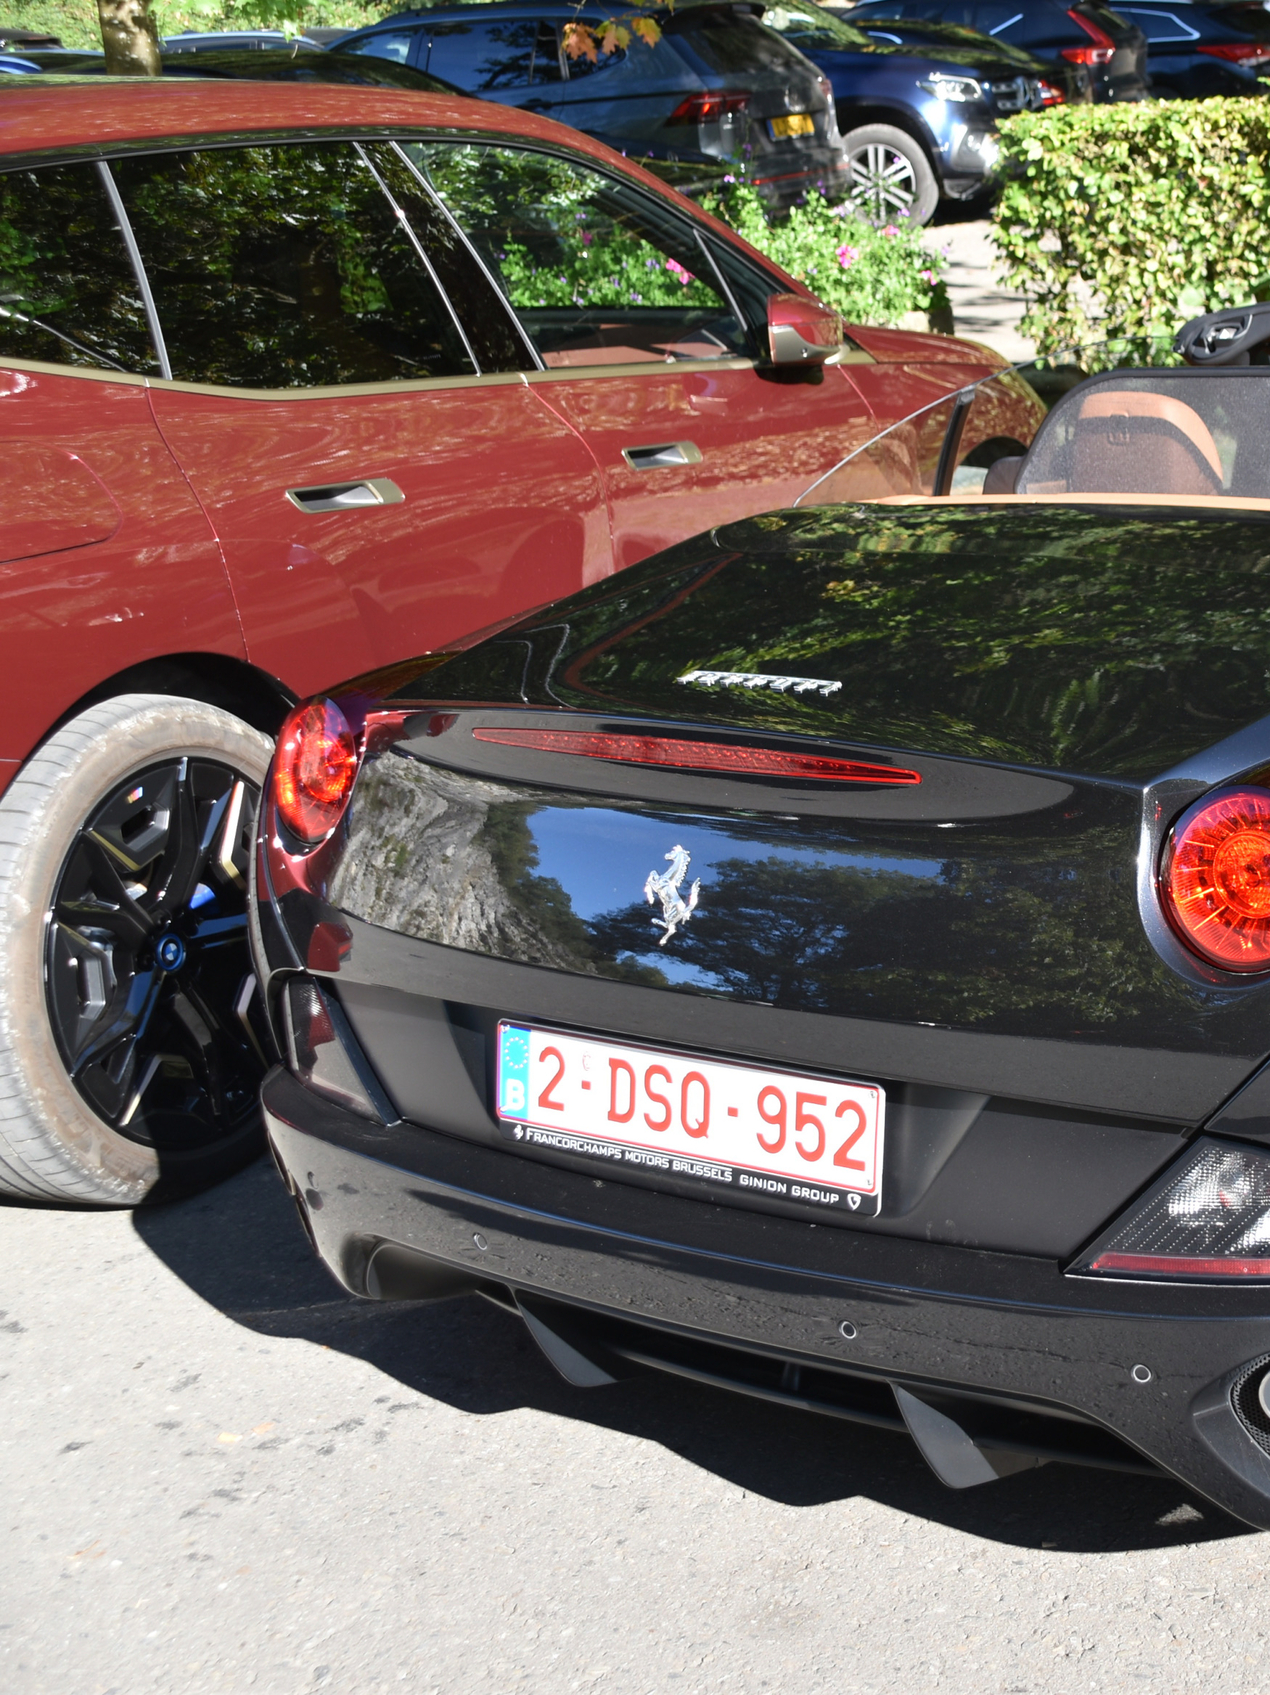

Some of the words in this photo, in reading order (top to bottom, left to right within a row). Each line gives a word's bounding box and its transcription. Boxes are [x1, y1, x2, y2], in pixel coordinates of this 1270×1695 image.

[506, 1078, 525, 1111] B
[526, 1127, 622, 1159] FRANCORCHAMPS
[625, 1151, 670, 1169] MOTORS
[672, 1160, 733, 1182] BRUSSELS
[739, 1174, 787, 1193] GINION
[791, 1185, 839, 1204] GROUP
